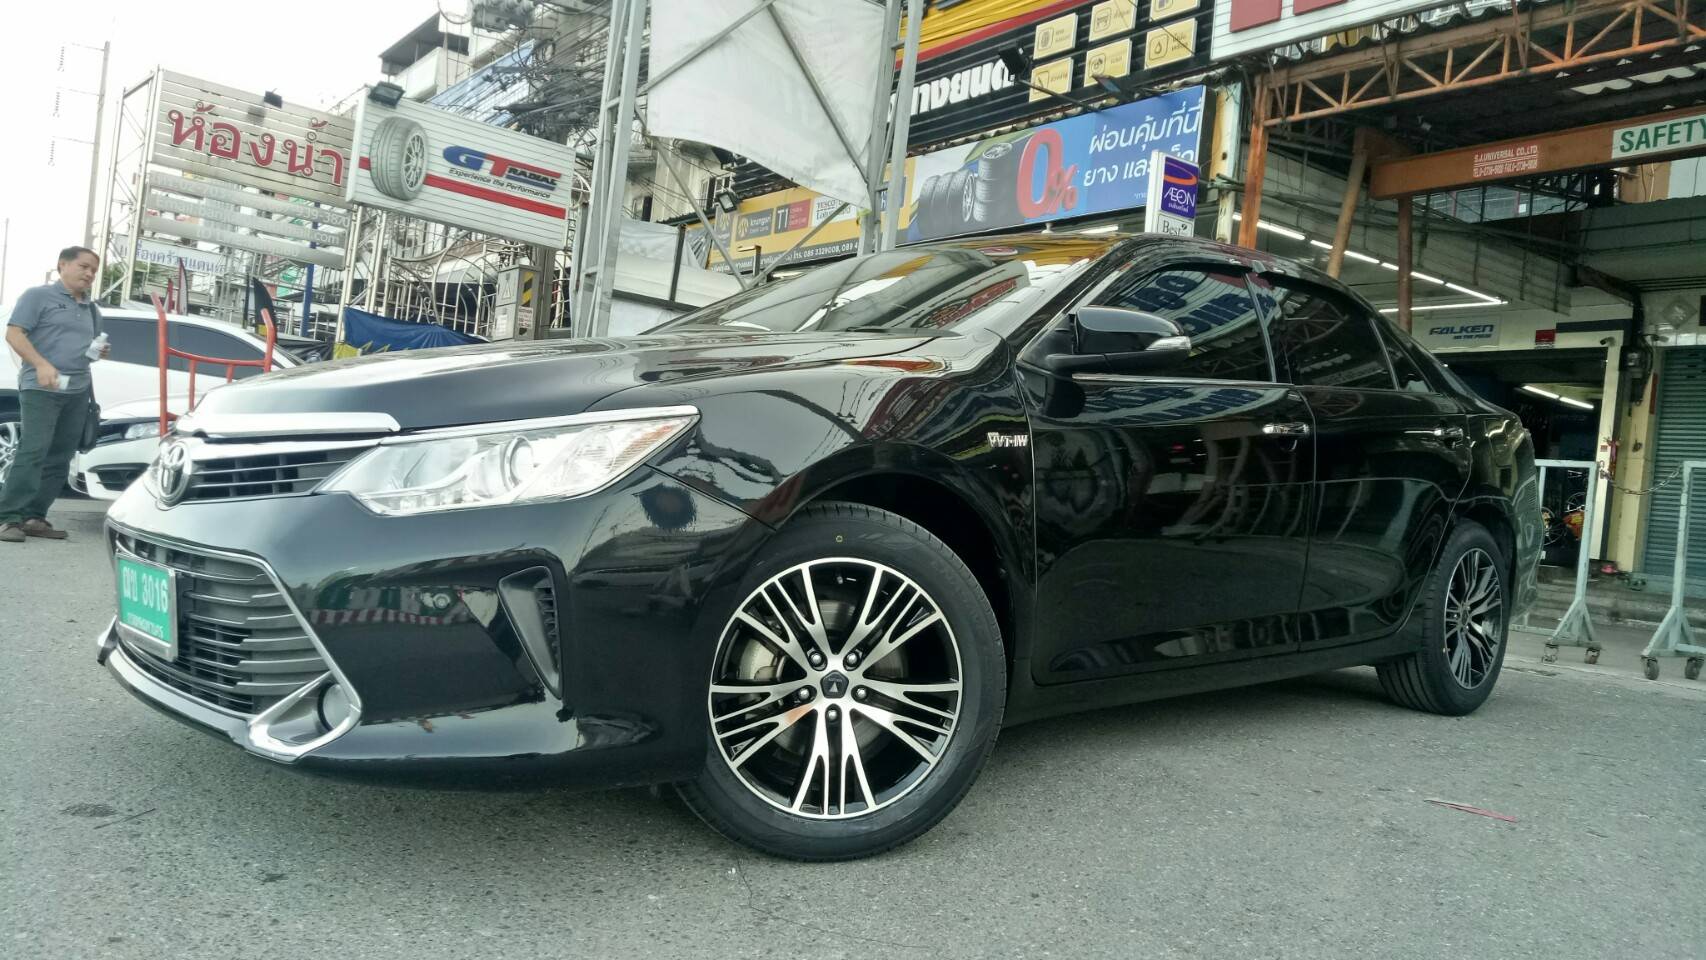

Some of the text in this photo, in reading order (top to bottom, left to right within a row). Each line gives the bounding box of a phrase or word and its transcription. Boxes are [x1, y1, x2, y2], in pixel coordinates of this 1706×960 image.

[168, 101, 343, 185] ห้องน้ำ
[449, 167, 551, 199] Experience the Performance
[507, 166, 557, 185] RADIAL
[1083, 164, 1119, 187] ยาง
[1429, 324, 1494, 336] FALKEN
[142, 572, 168, 613] 3016
